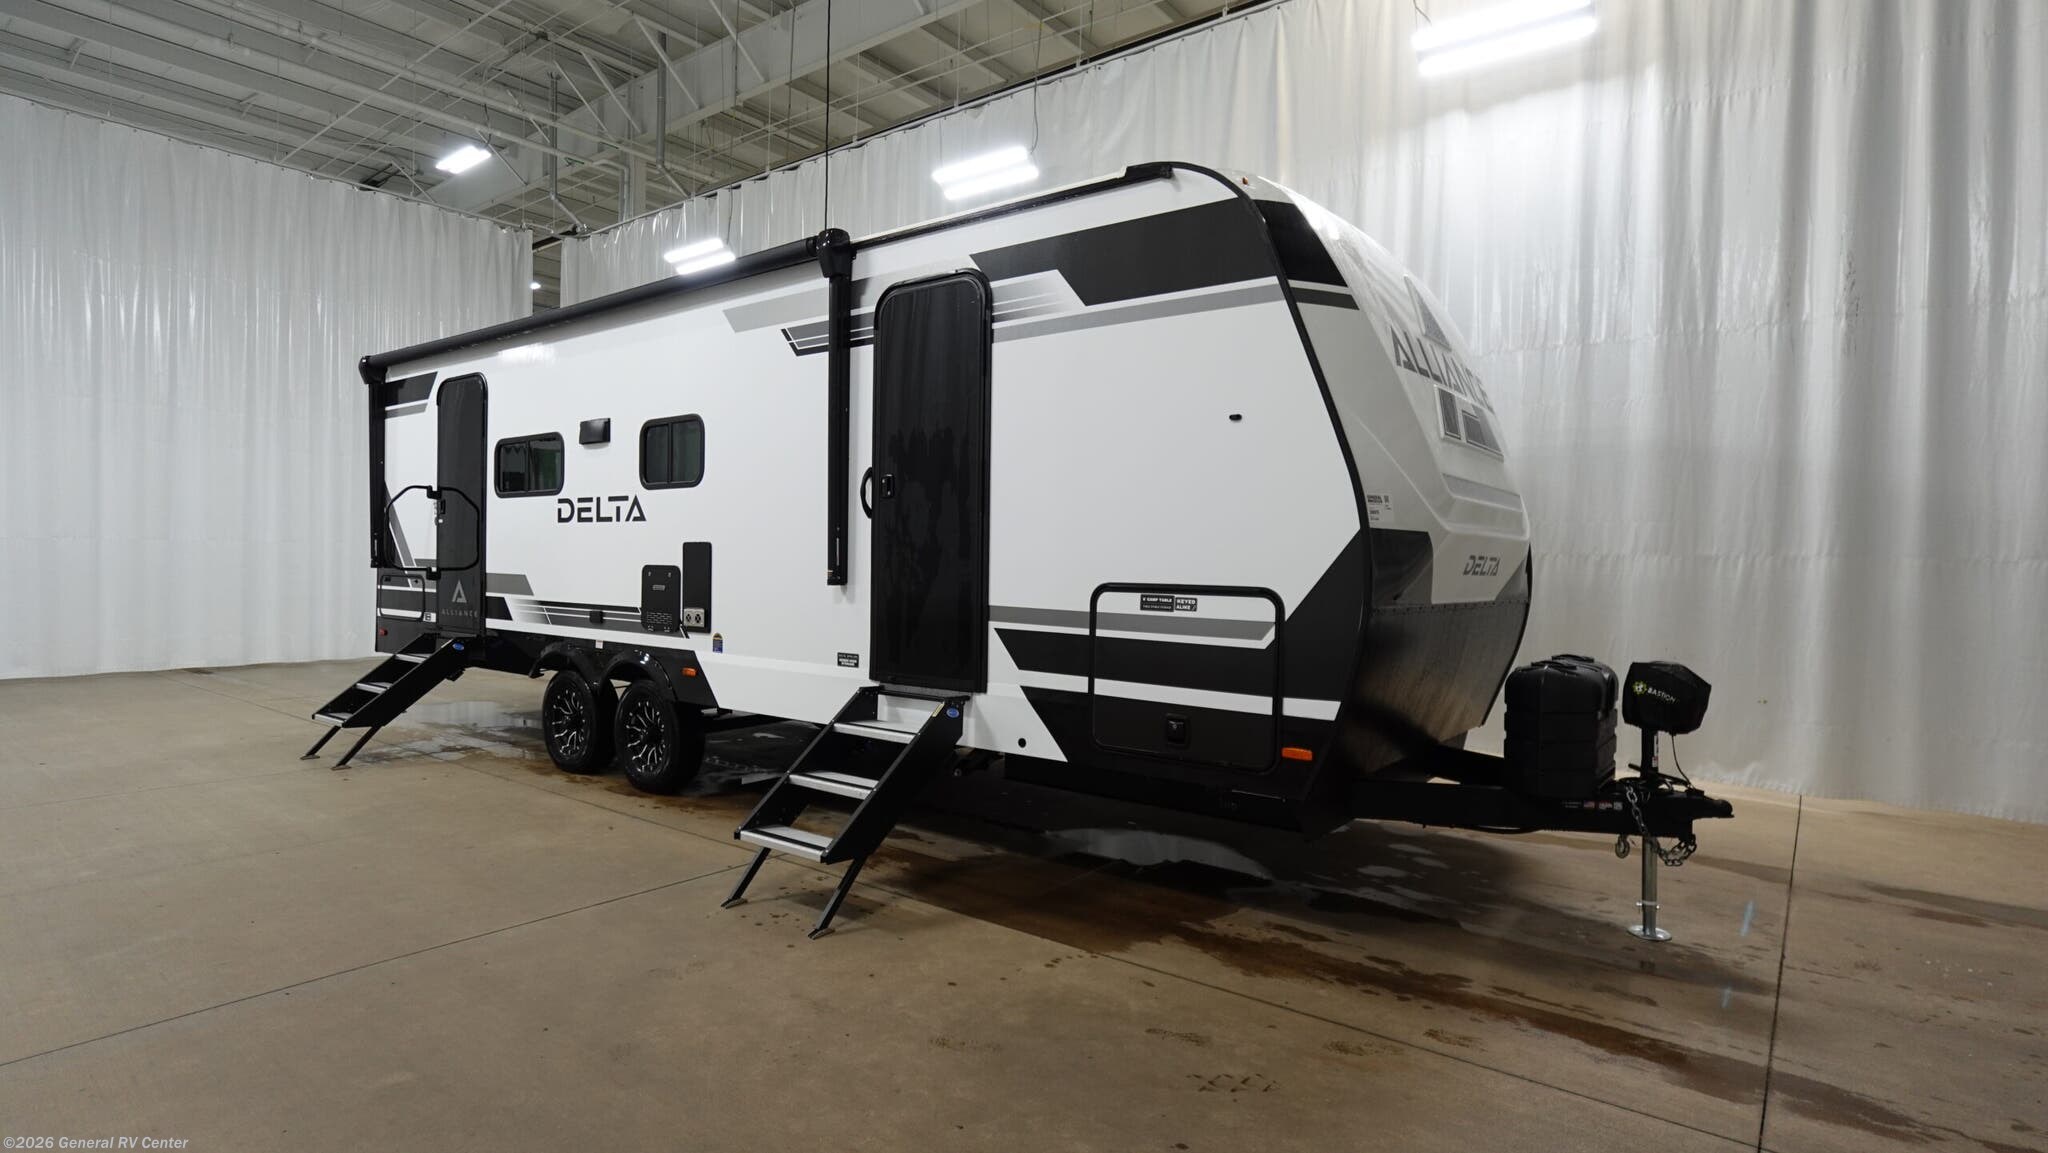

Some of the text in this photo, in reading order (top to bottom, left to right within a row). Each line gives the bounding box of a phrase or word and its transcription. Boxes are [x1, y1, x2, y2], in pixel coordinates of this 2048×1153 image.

[1389, 325, 1497, 416] ALLIANCE
[557, 494, 647, 523] DELTA
[1463, 554, 1501, 576] DELTA
[441, 608, 479, 617] ALLIANCE
[1647, 686, 1677, 702] BASTION
